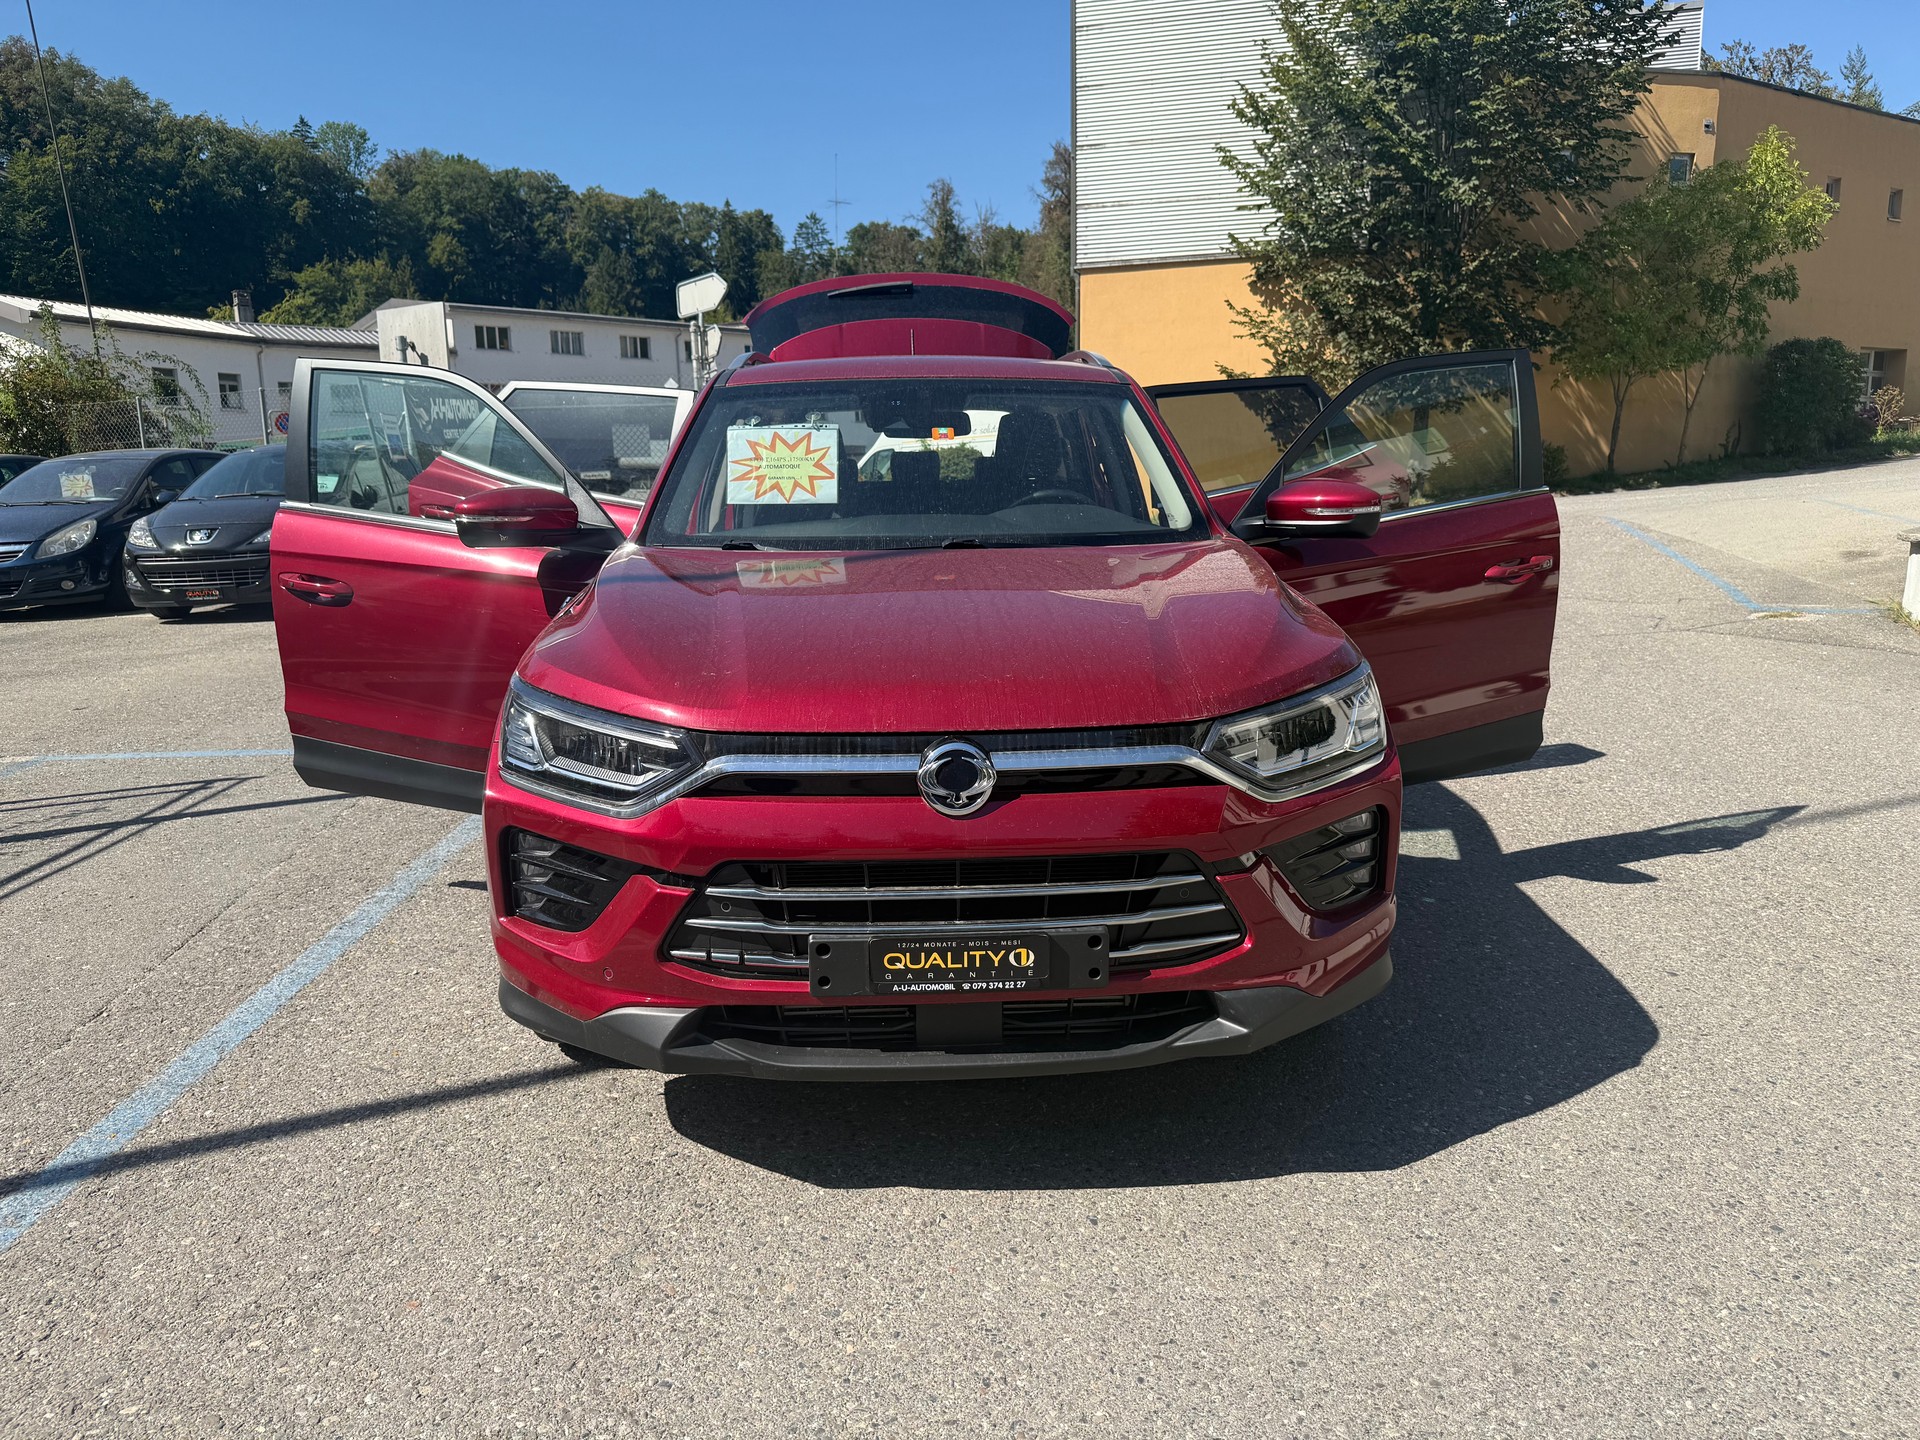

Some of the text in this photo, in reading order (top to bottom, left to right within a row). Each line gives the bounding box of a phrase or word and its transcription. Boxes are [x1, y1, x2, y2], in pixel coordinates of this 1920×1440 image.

[883, 949, 1006, 970] QUALITY
[885, 969, 1034, 980] GARANTIE
[892, 980, 1026, 992] A-U-AUTOMOBIL 079 374 22 27
